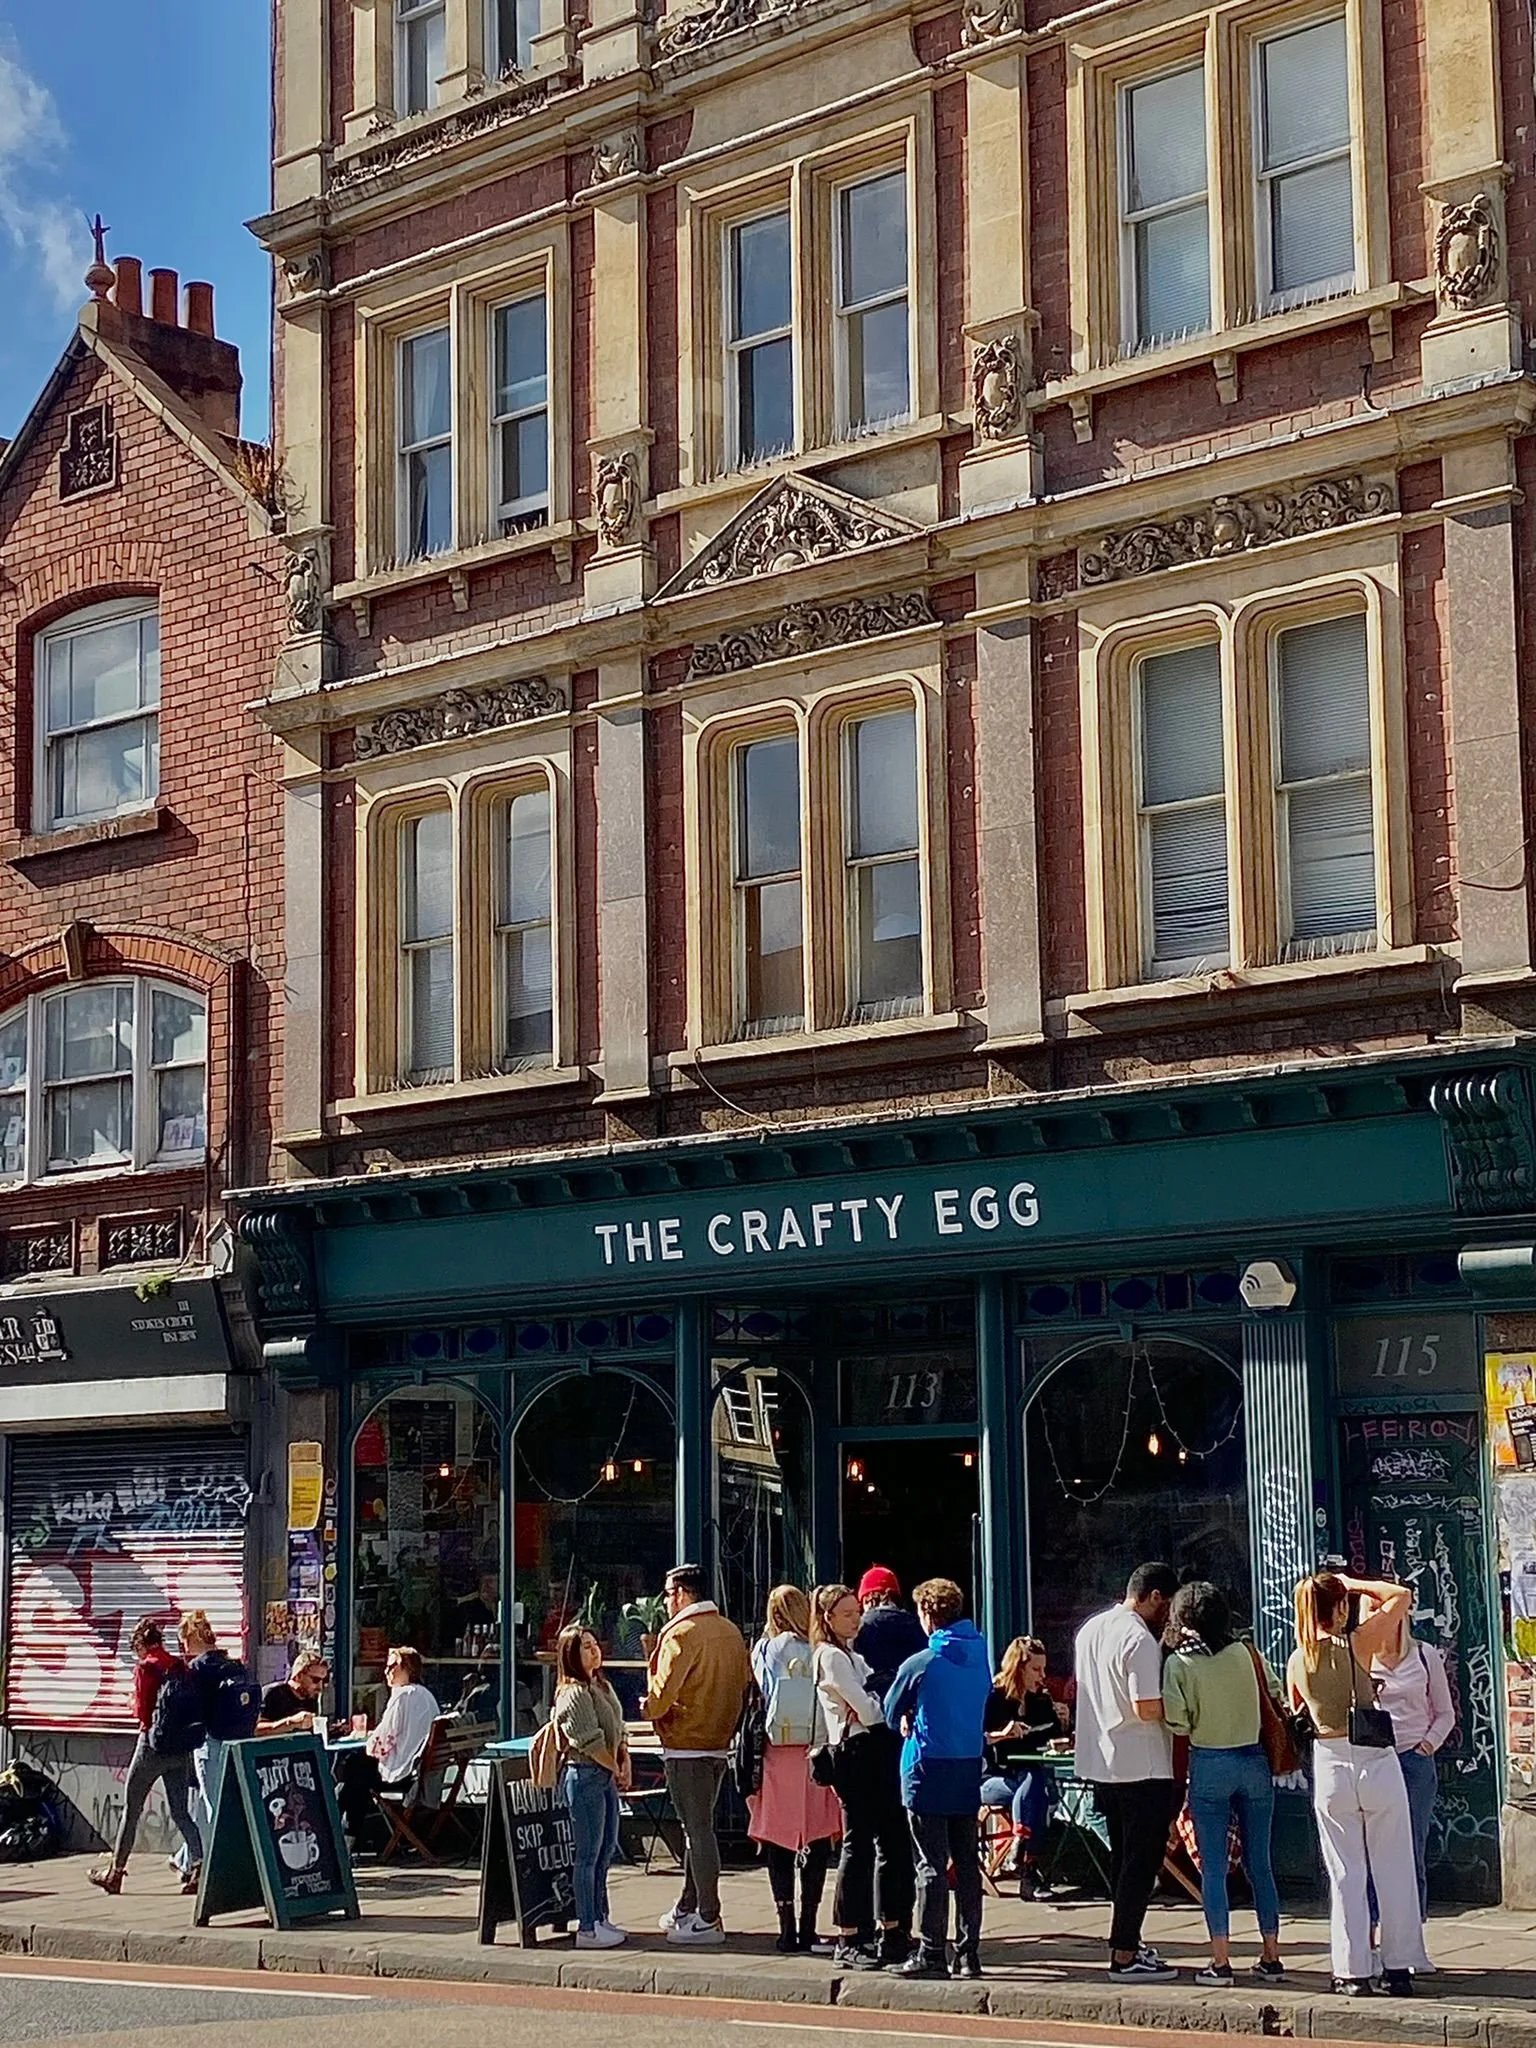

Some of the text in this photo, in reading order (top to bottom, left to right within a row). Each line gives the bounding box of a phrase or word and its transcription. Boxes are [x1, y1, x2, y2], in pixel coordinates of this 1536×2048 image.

[595, 1183, 1040, 1265] THE CRAFTY EGG
[1370, 1335, 1441, 1378] 115
[885, 1372, 938, 1409] 113
[516, 1819, 573, 1850] SKIP TH
